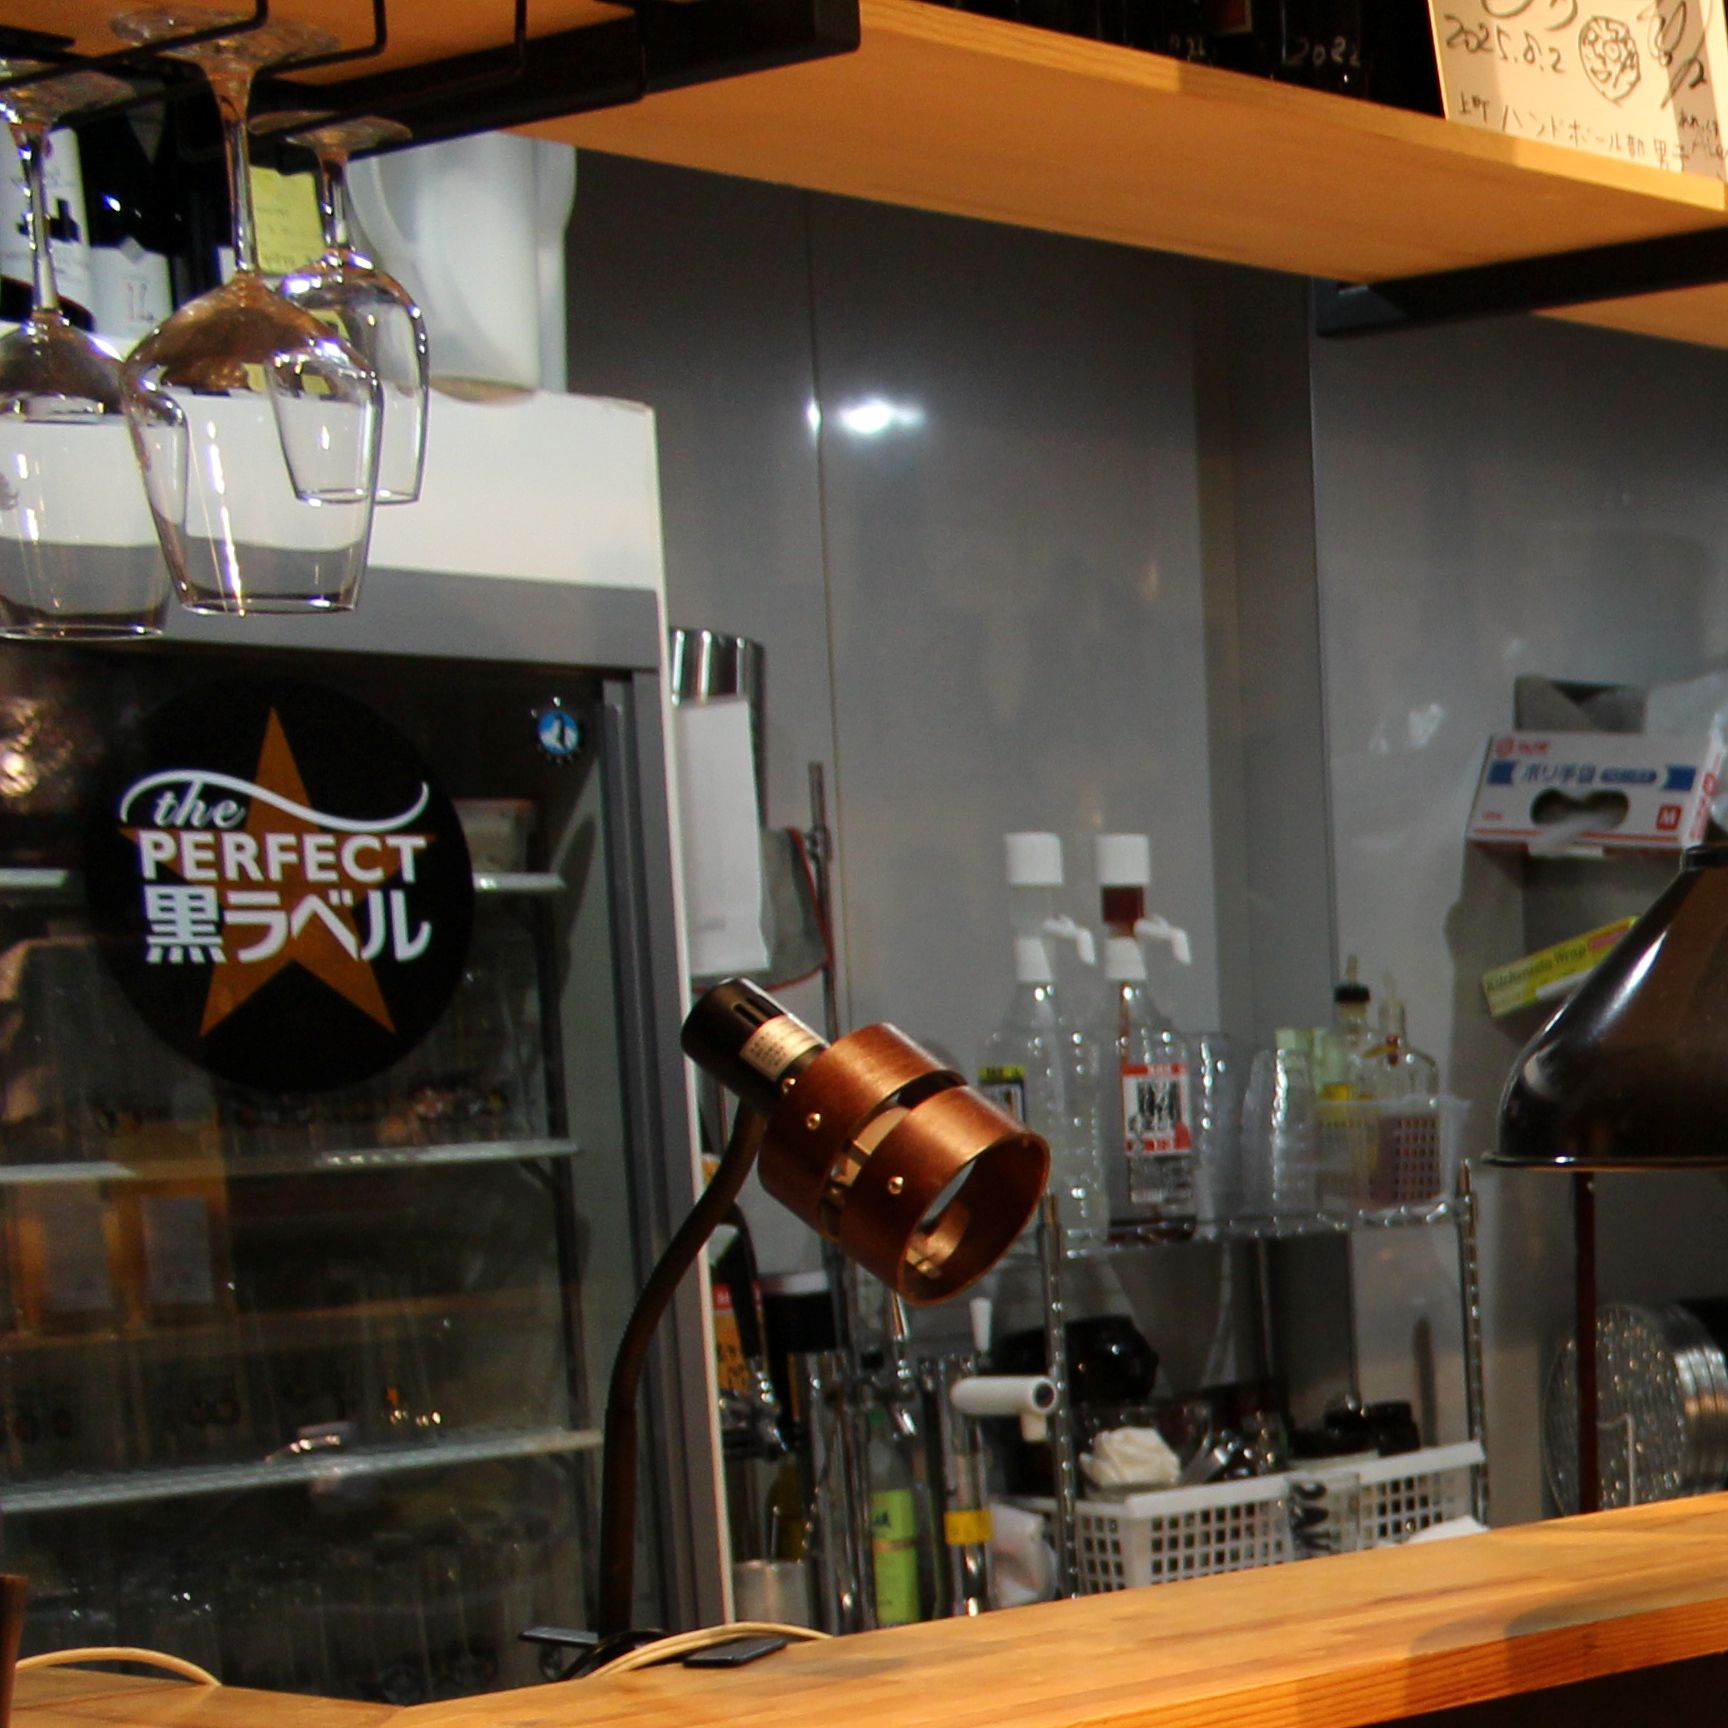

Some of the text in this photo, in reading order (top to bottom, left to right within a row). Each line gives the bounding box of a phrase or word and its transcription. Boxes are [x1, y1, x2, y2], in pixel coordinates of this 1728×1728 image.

[153, 779, 246, 826] the
[141, 831, 427, 882] PERFECT
[144, 884, 432, 964] 黒ラベル
